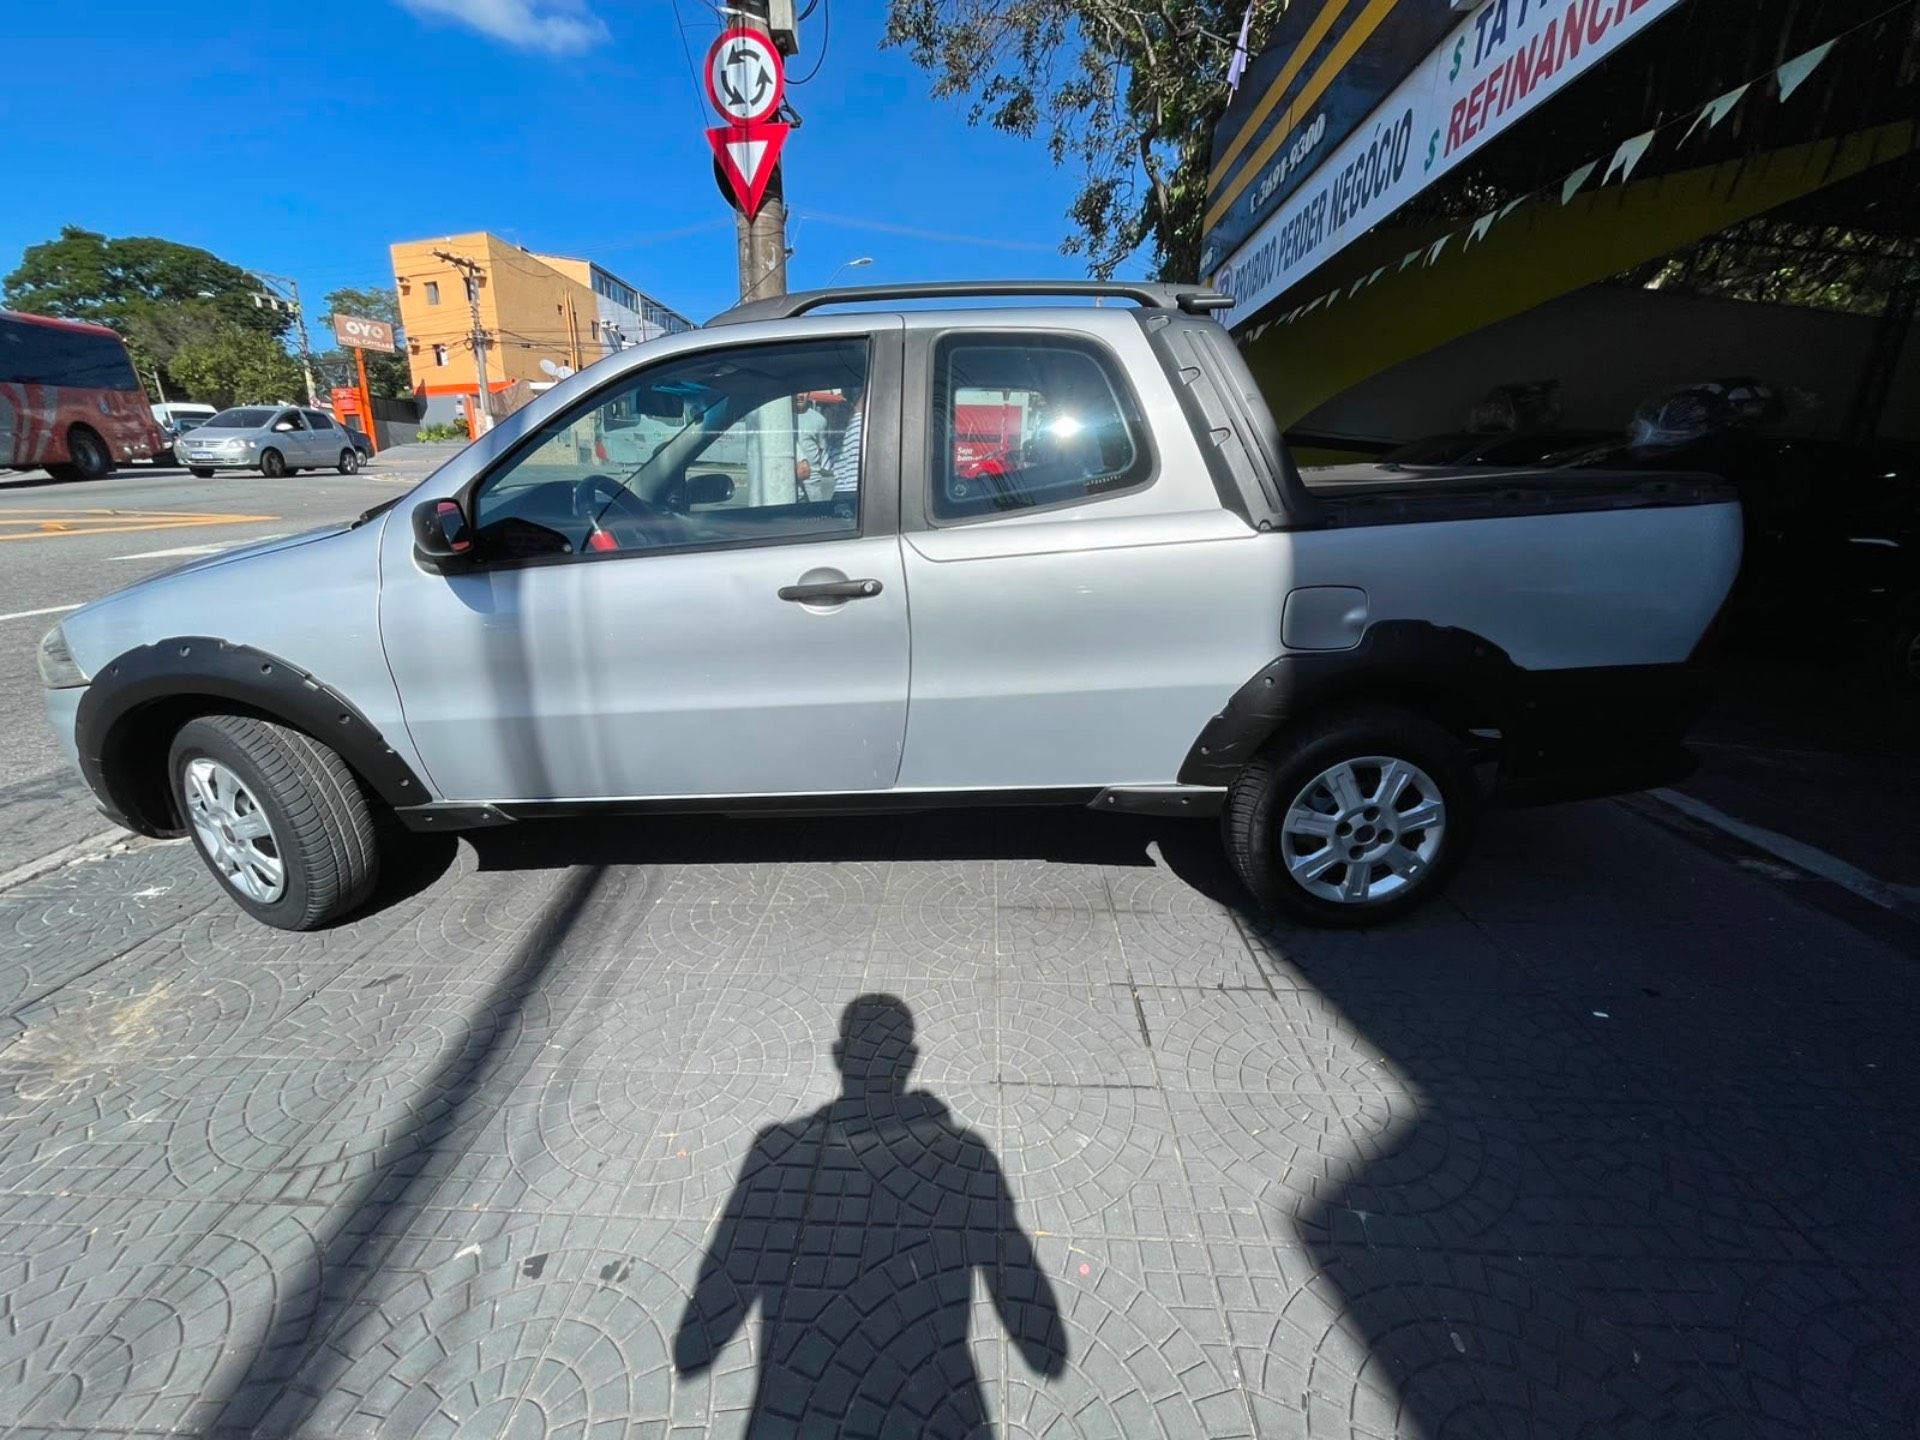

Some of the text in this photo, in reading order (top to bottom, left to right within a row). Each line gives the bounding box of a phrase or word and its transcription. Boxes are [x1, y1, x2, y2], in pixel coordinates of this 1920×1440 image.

[1234, 108, 1413, 308] PROIBIDO PERDER NEGÓCIO
[345, 321, 385, 339] OYO
